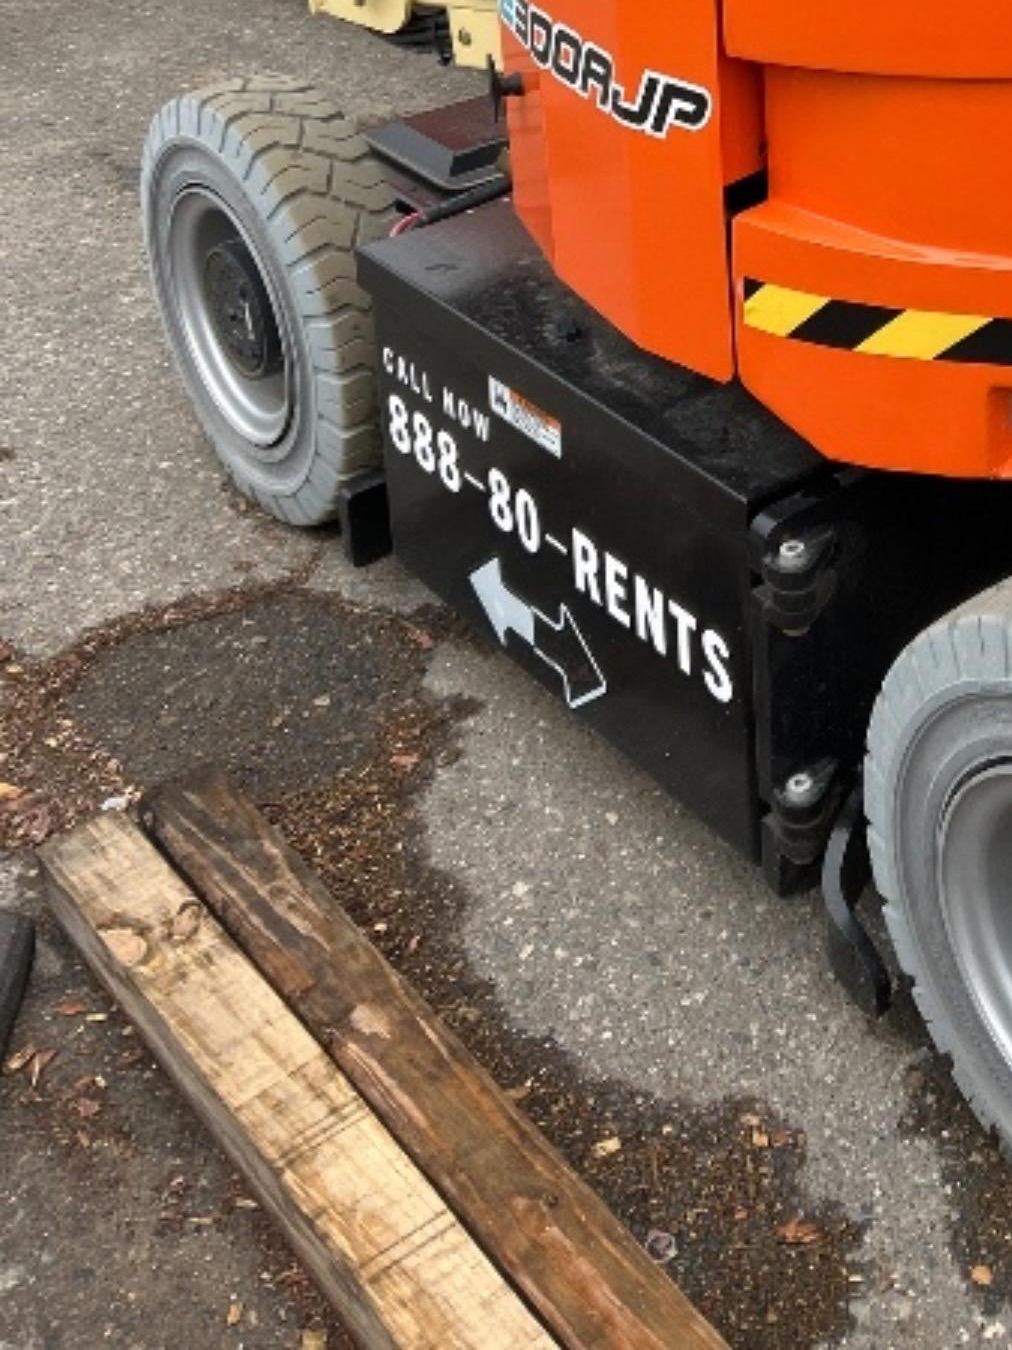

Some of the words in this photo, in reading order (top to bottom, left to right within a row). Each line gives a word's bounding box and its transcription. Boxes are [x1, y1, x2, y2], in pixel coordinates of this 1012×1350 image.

[382, 346, 433, 403] CALL
[442, 385, 490, 442] NOW
[387, 394, 733, 705] 888-80-RENTS
